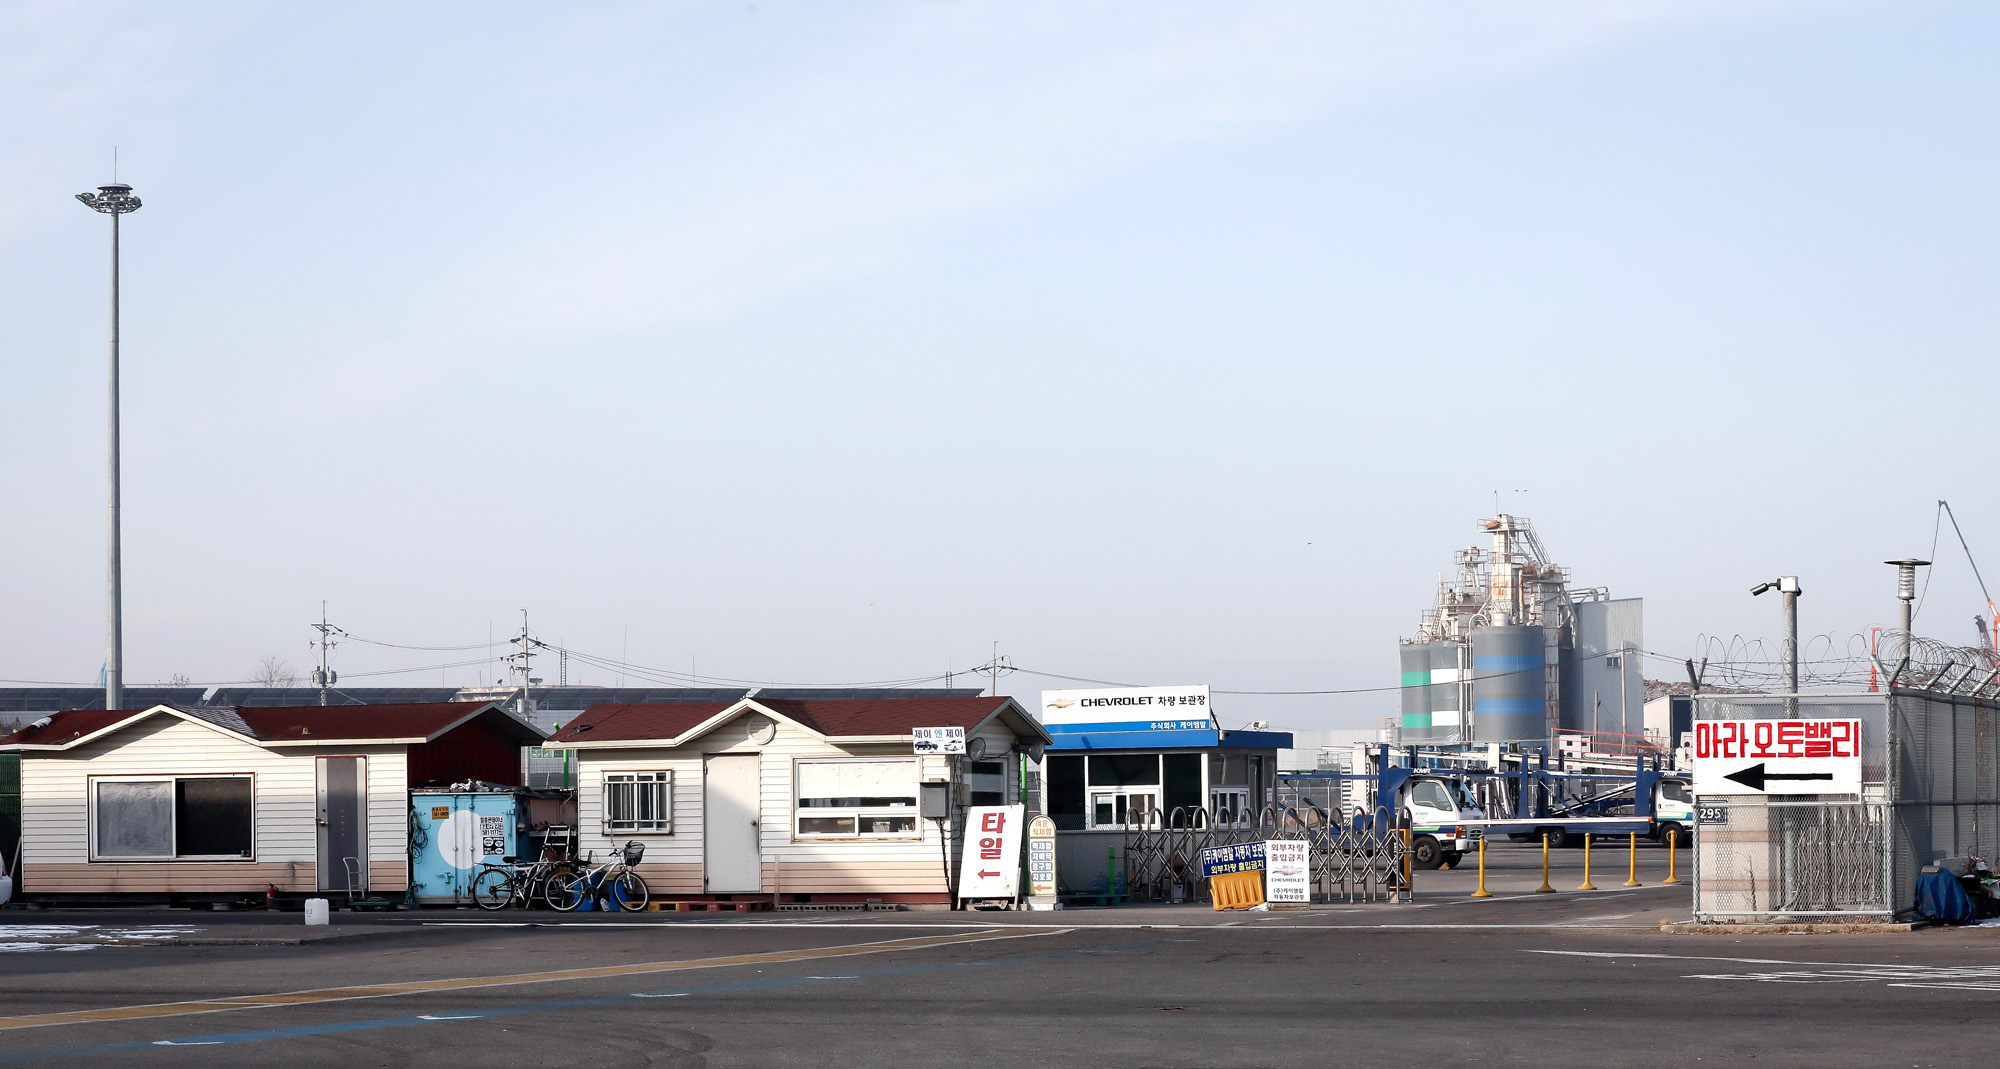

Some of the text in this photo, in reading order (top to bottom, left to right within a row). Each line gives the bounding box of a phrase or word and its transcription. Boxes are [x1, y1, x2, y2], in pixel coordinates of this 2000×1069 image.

[1081, 695, 1206, 707] CHEVROLET 차량 보관장
[1150, 722, 1177, 731] 주식회사
[914, 728, 963, 739] 제이 엔 제이
[1700, 808, 1721, 819] 295
[979, 812, 1006, 860] 타일
[1032, 828, 1052, 836] 적재함
[1234, 844, 1251, 860] 자동차
[1271, 843, 1304, 852] 외부차량
[1271, 853, 1304, 861] 출입금지
[1211, 860, 1264, 874] 외부차량 출입금지
